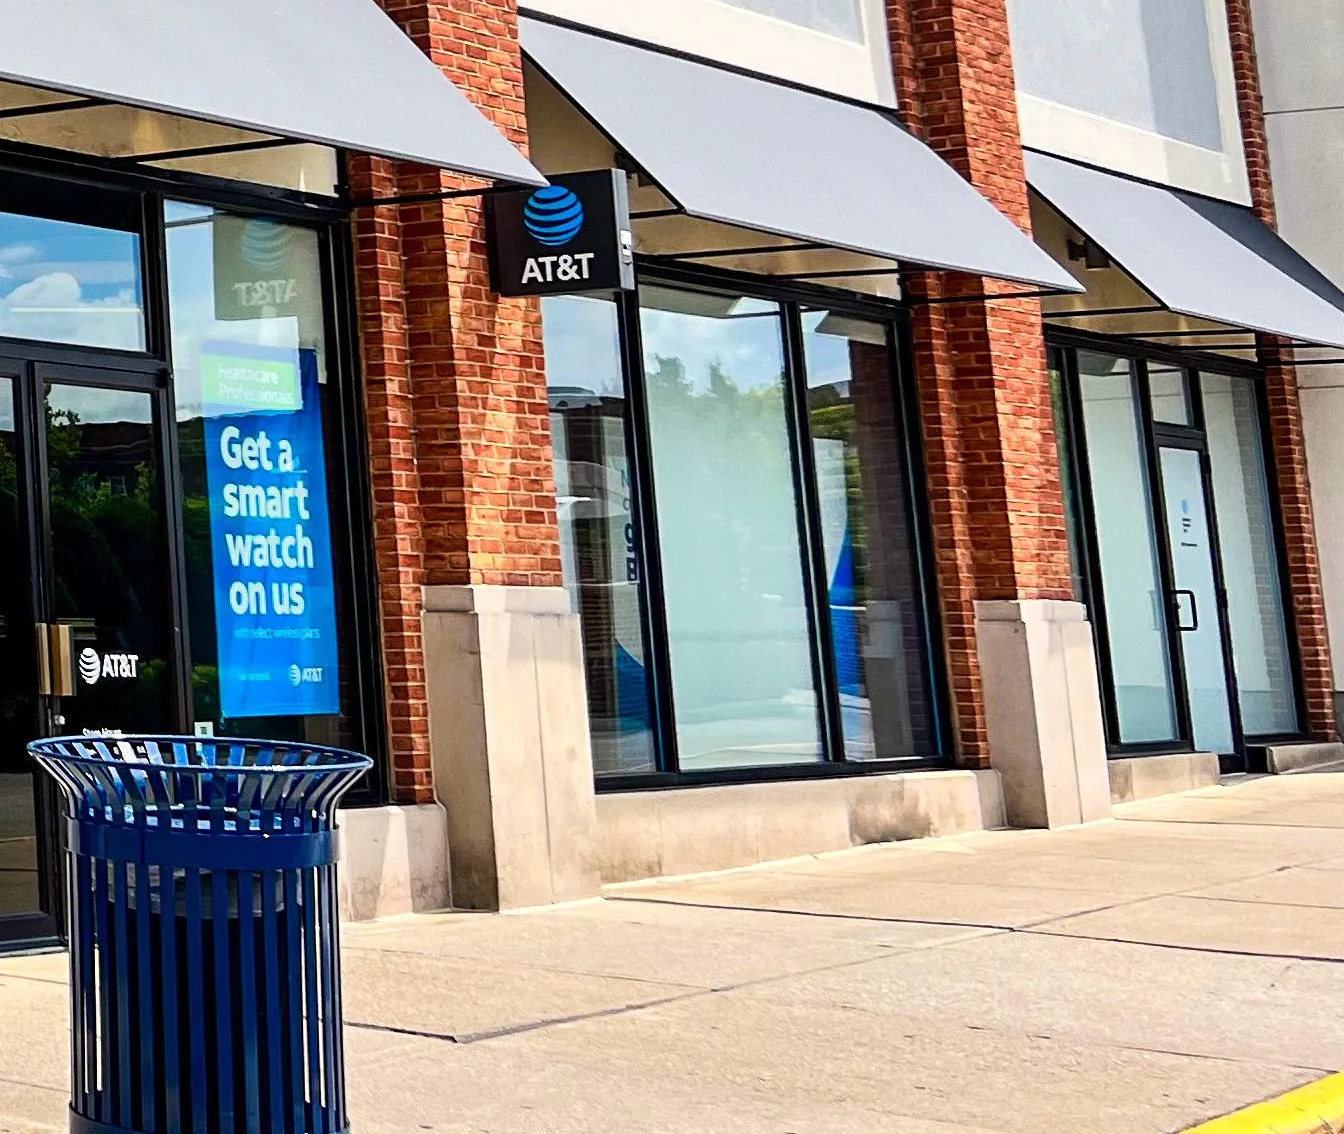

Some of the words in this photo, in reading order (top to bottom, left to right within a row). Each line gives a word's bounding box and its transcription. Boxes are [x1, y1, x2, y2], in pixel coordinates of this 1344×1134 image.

[521, 253, 594, 284] AT&T
[220, 425, 273, 471] Get
[278, 439, 293, 473] a
[223, 480, 310, 520] smart
[226, 523, 314, 568] watch
[229, 581, 266, 615] on
[271, 581, 305, 616] us
[102, 654, 139, 678] AT&T
[301, 667, 323, 683] AT&T
